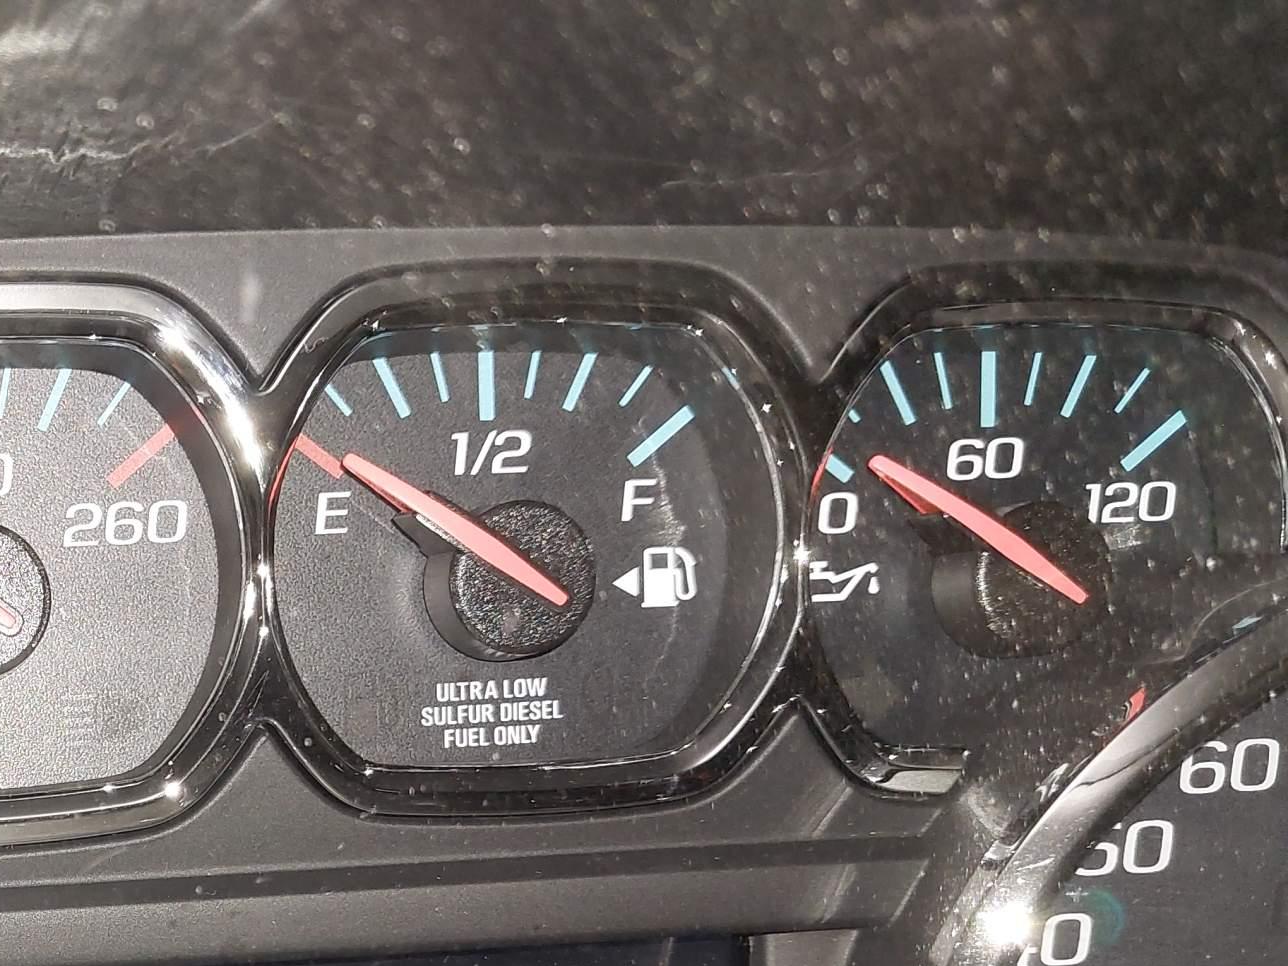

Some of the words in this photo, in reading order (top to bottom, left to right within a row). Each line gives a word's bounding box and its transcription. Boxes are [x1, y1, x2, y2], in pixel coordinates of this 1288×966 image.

[450, 429, 533, 475] 1/2
[946, 437, 1025, 482] 60
[314, 491, 351, 535] E
[621, 479, 656, 522] F
[818, 491, 859, 535] 0
[1085, 480, 1177, 523] 120
[63, 500, 188, 548] 260
[435, 683, 497, 701] ULTRA
[503, 678, 548, 699] LOW
[420, 705, 495, 726] SULFUR
[499, 701, 564, 722] DIESEL
[443, 729, 489, 748] FUEL
[493, 725, 541, 746] ONLY
[1179, 738, 1280, 794] 60
